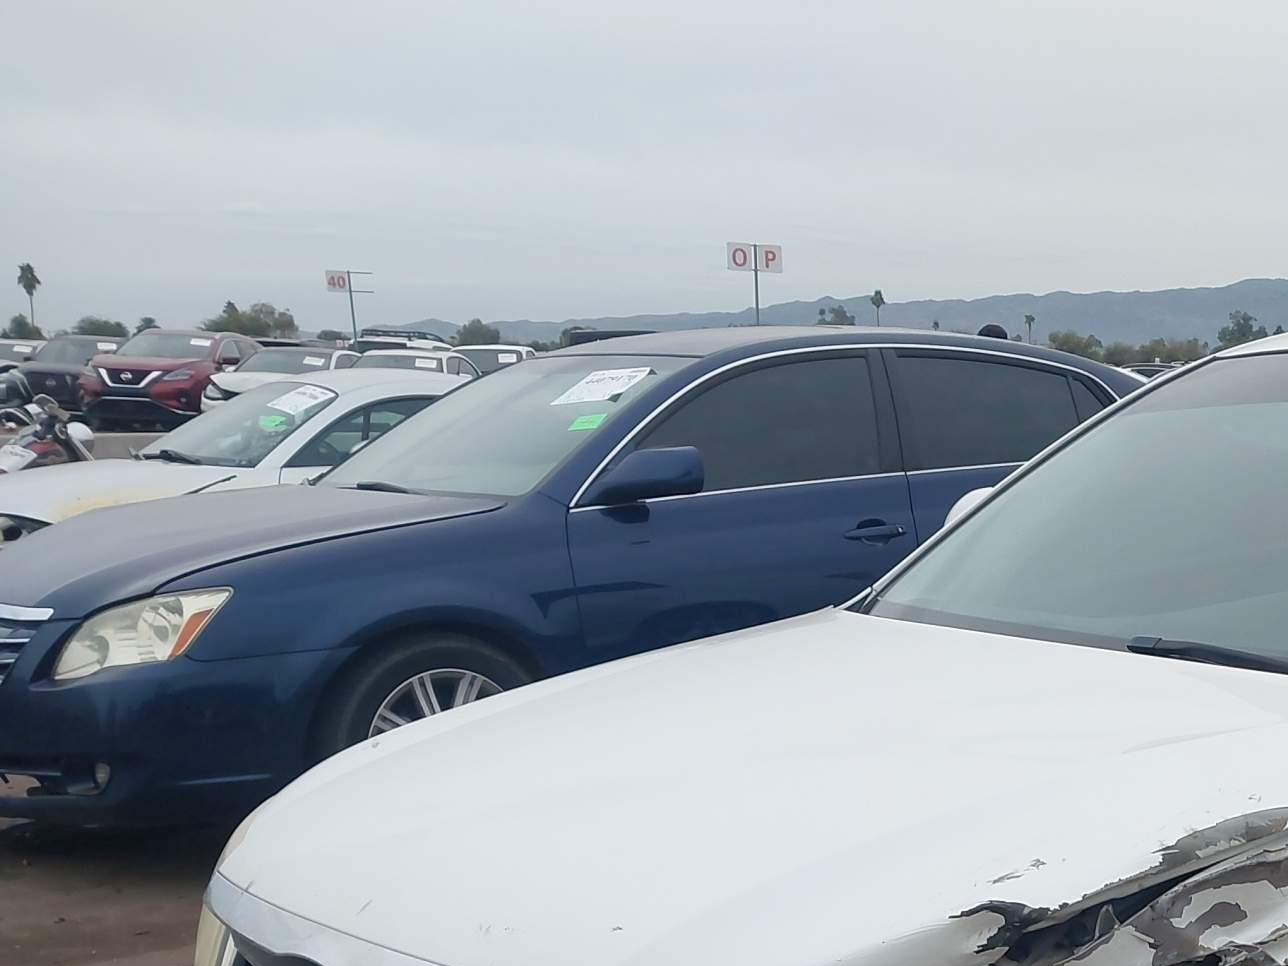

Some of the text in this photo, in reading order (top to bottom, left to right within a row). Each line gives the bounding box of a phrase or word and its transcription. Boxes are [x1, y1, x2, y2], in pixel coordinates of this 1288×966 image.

[732, 248, 777, 269] O P
[327, 275, 346, 289] 40
